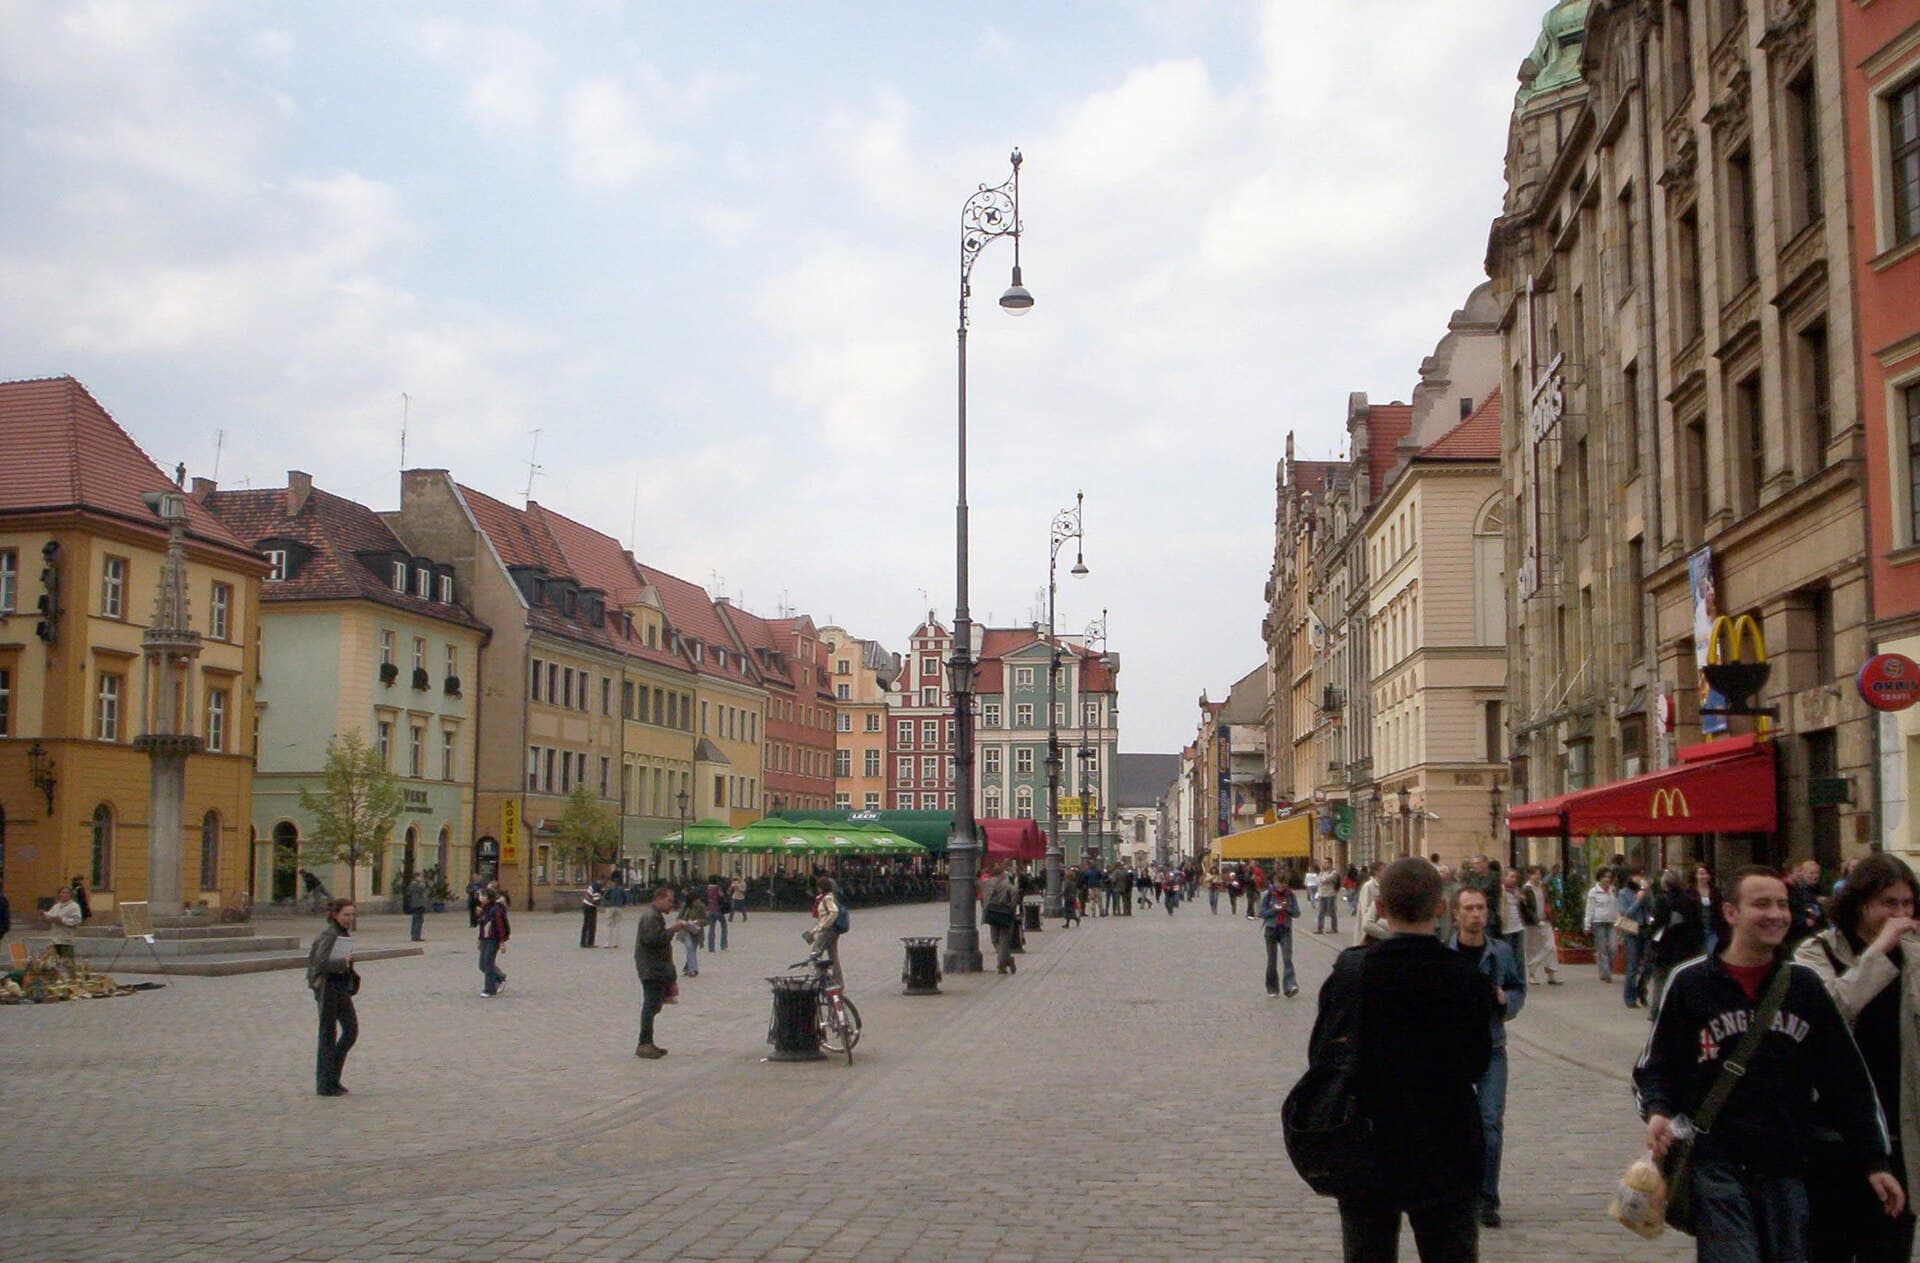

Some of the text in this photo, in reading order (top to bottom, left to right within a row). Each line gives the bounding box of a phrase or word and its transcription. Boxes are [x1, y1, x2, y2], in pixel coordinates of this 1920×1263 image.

[1872, 681, 1918, 691] ORBIS
[1454, 773, 1483, 786] PKO
[1709, 1009, 1810, 1043] ENGAND
